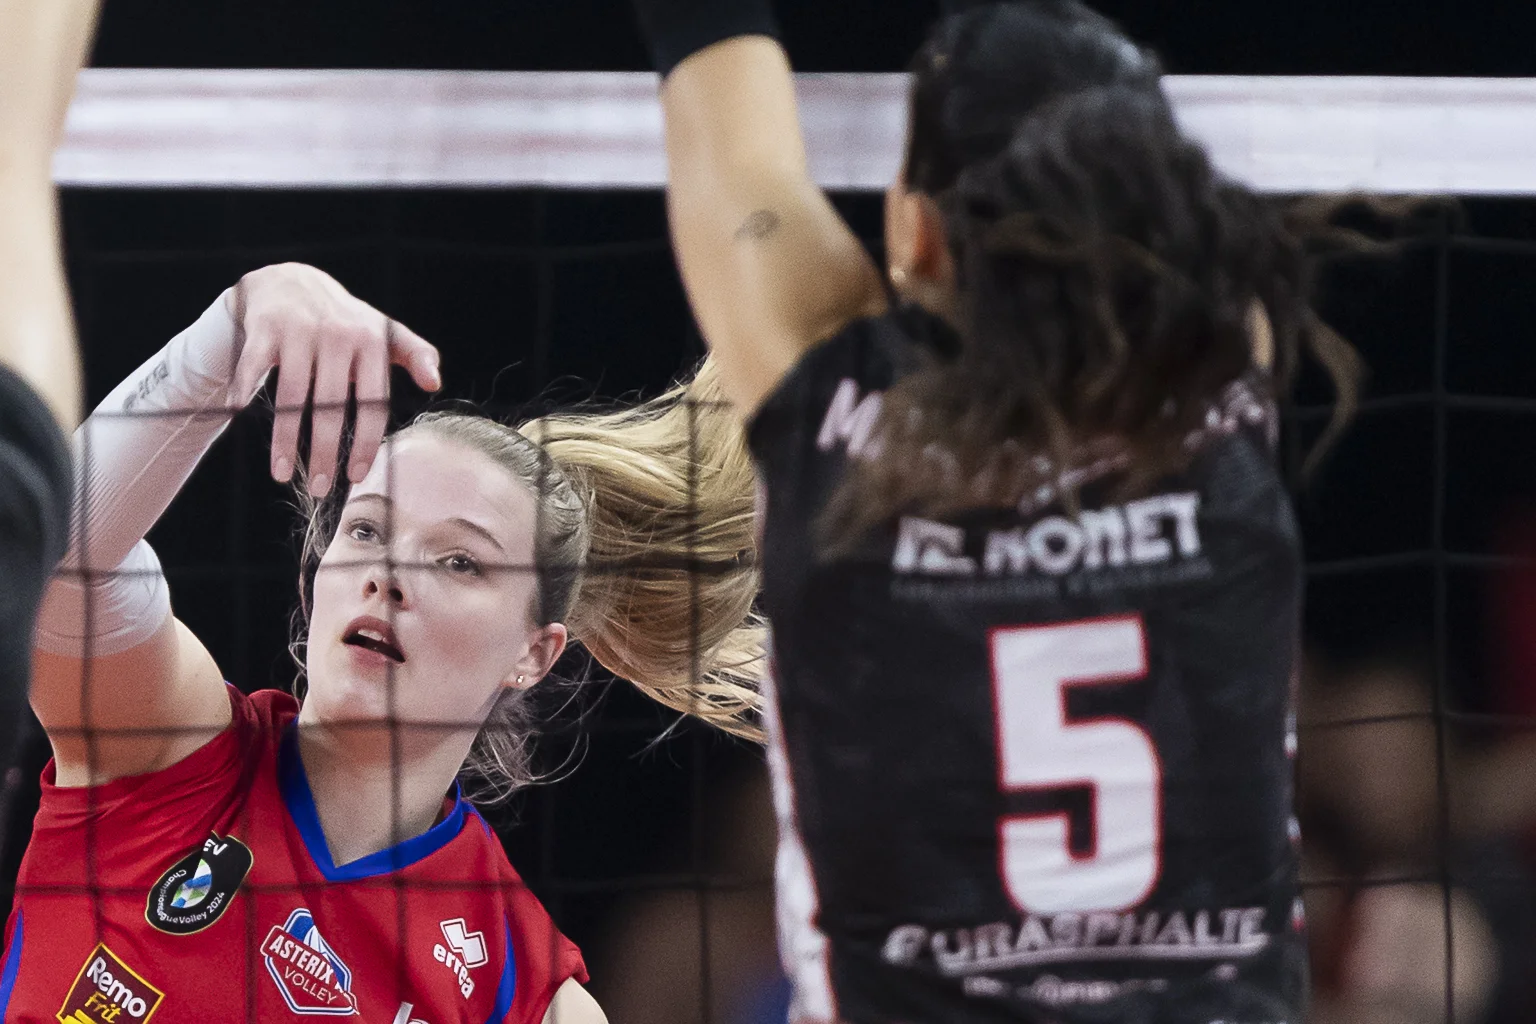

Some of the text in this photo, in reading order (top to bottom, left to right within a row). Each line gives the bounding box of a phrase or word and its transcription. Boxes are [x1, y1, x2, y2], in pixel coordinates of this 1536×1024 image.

[987, 613, 1164, 918] 5
[206, 891, 226, 914] 2024
[268, 934, 335, 985] ASTERIX
[84, 991, 121, 1024] Frit
[86, 956, 147, 1018] Remo
[284, 965, 338, 1005] VOLLEY
